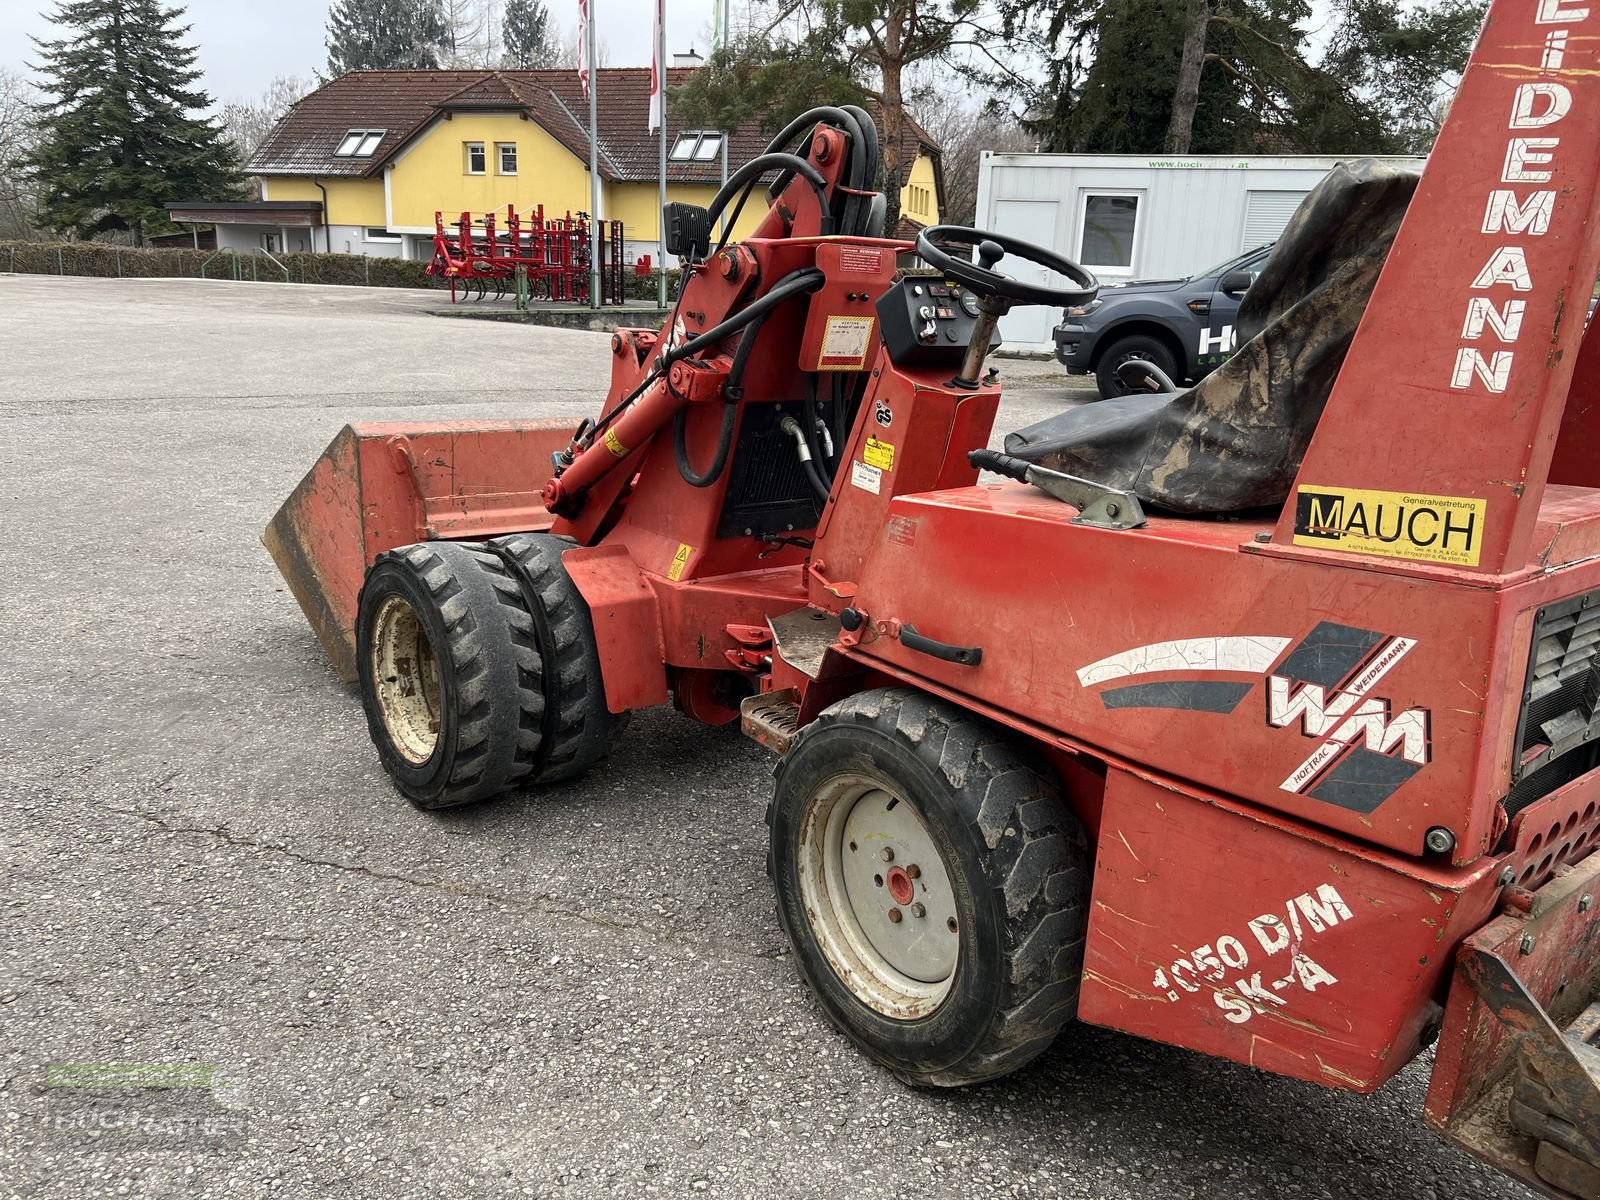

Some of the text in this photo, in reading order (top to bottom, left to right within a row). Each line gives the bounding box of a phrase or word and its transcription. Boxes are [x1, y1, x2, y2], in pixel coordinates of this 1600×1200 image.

[1307, 497, 1475, 551] MAUCH
[1402, 496, 1476, 510] Generalvertretung
[1353, 640, 1408, 694] WEIDEMANN
[1293, 747, 1330, 785] HOFTRAC
[1152, 883, 1354, 1002] 1050 D/M
[1213, 951, 1339, 1024] SK-A
